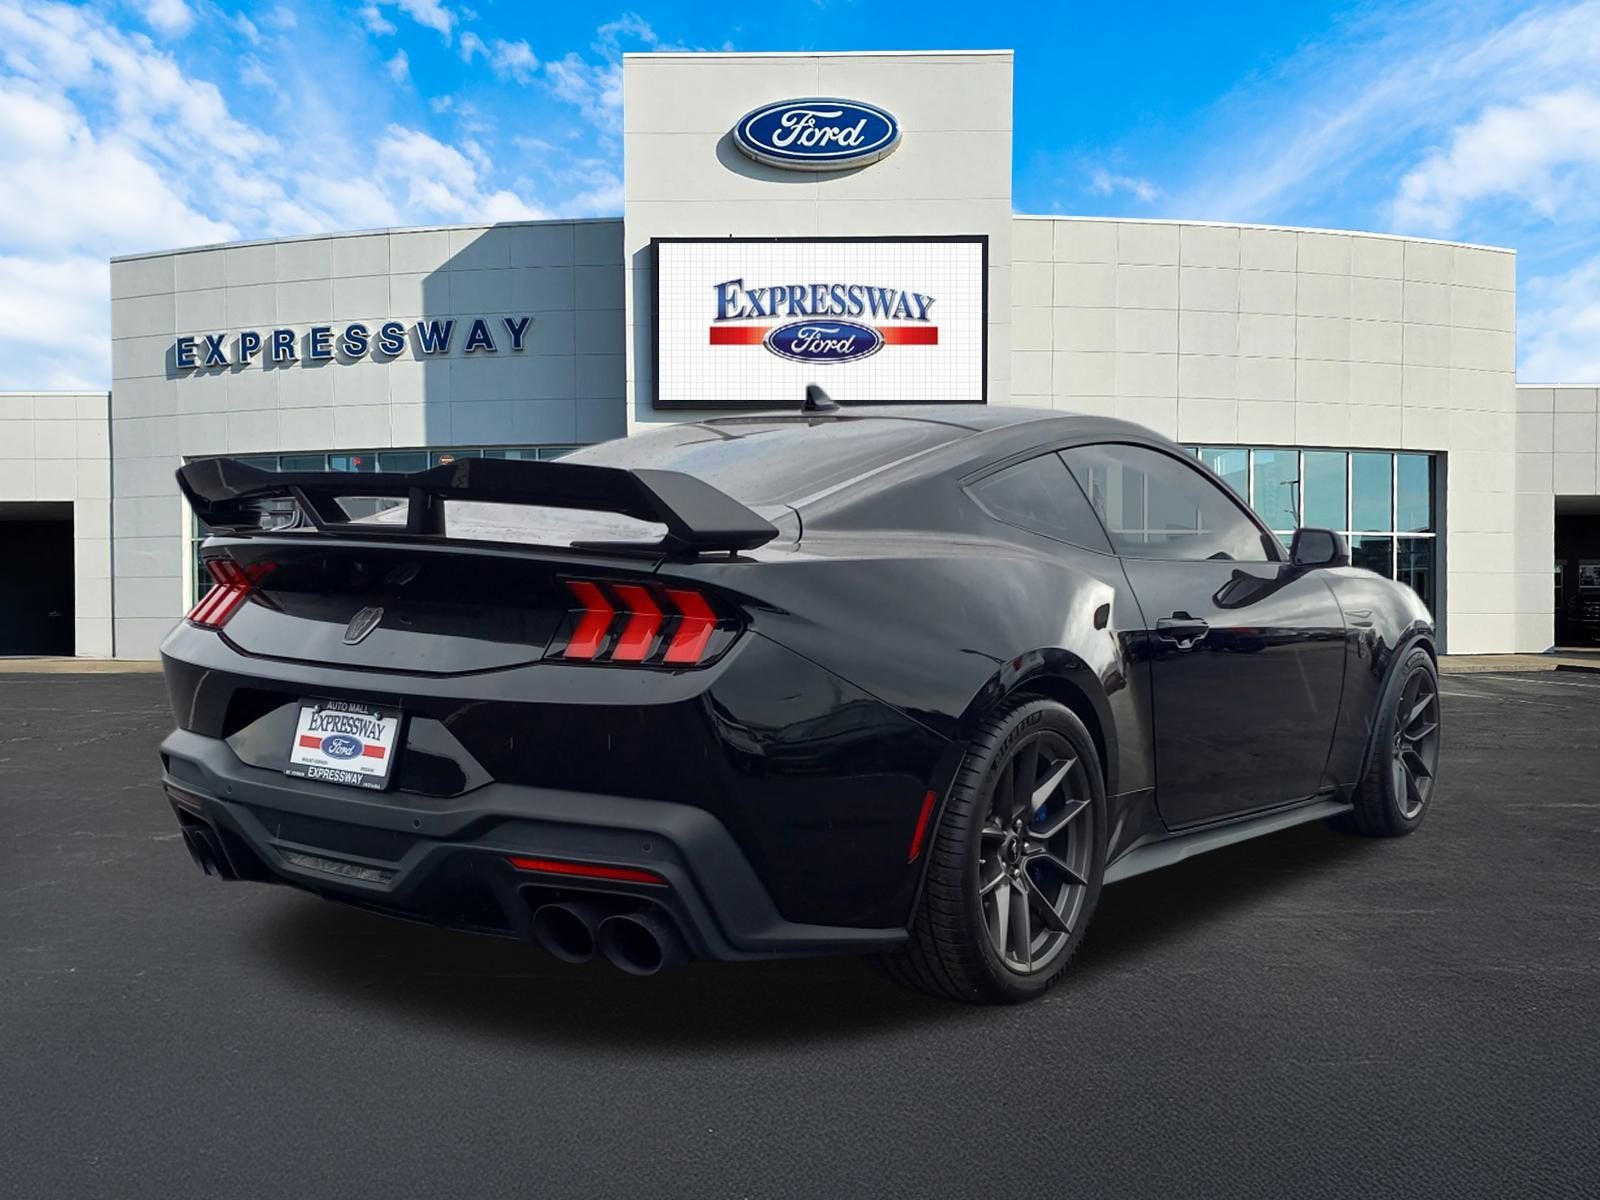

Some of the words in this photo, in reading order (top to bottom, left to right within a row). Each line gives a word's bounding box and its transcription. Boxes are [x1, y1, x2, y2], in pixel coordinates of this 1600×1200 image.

[772, 110, 868, 147] Ford
[713, 278, 936, 322] EXPRESSWAY
[175, 316, 531, 369] EXPRESSWAY
[790, 326, 855, 354] Ford
[327, 701, 347, 711] AUTO
[349, 703, 368, 714] MALL
[308, 712, 385, 740] EXPRESSWAY
[328, 739, 355, 756] Ford
[307, 767, 363, 785] EXPRESSWAY
